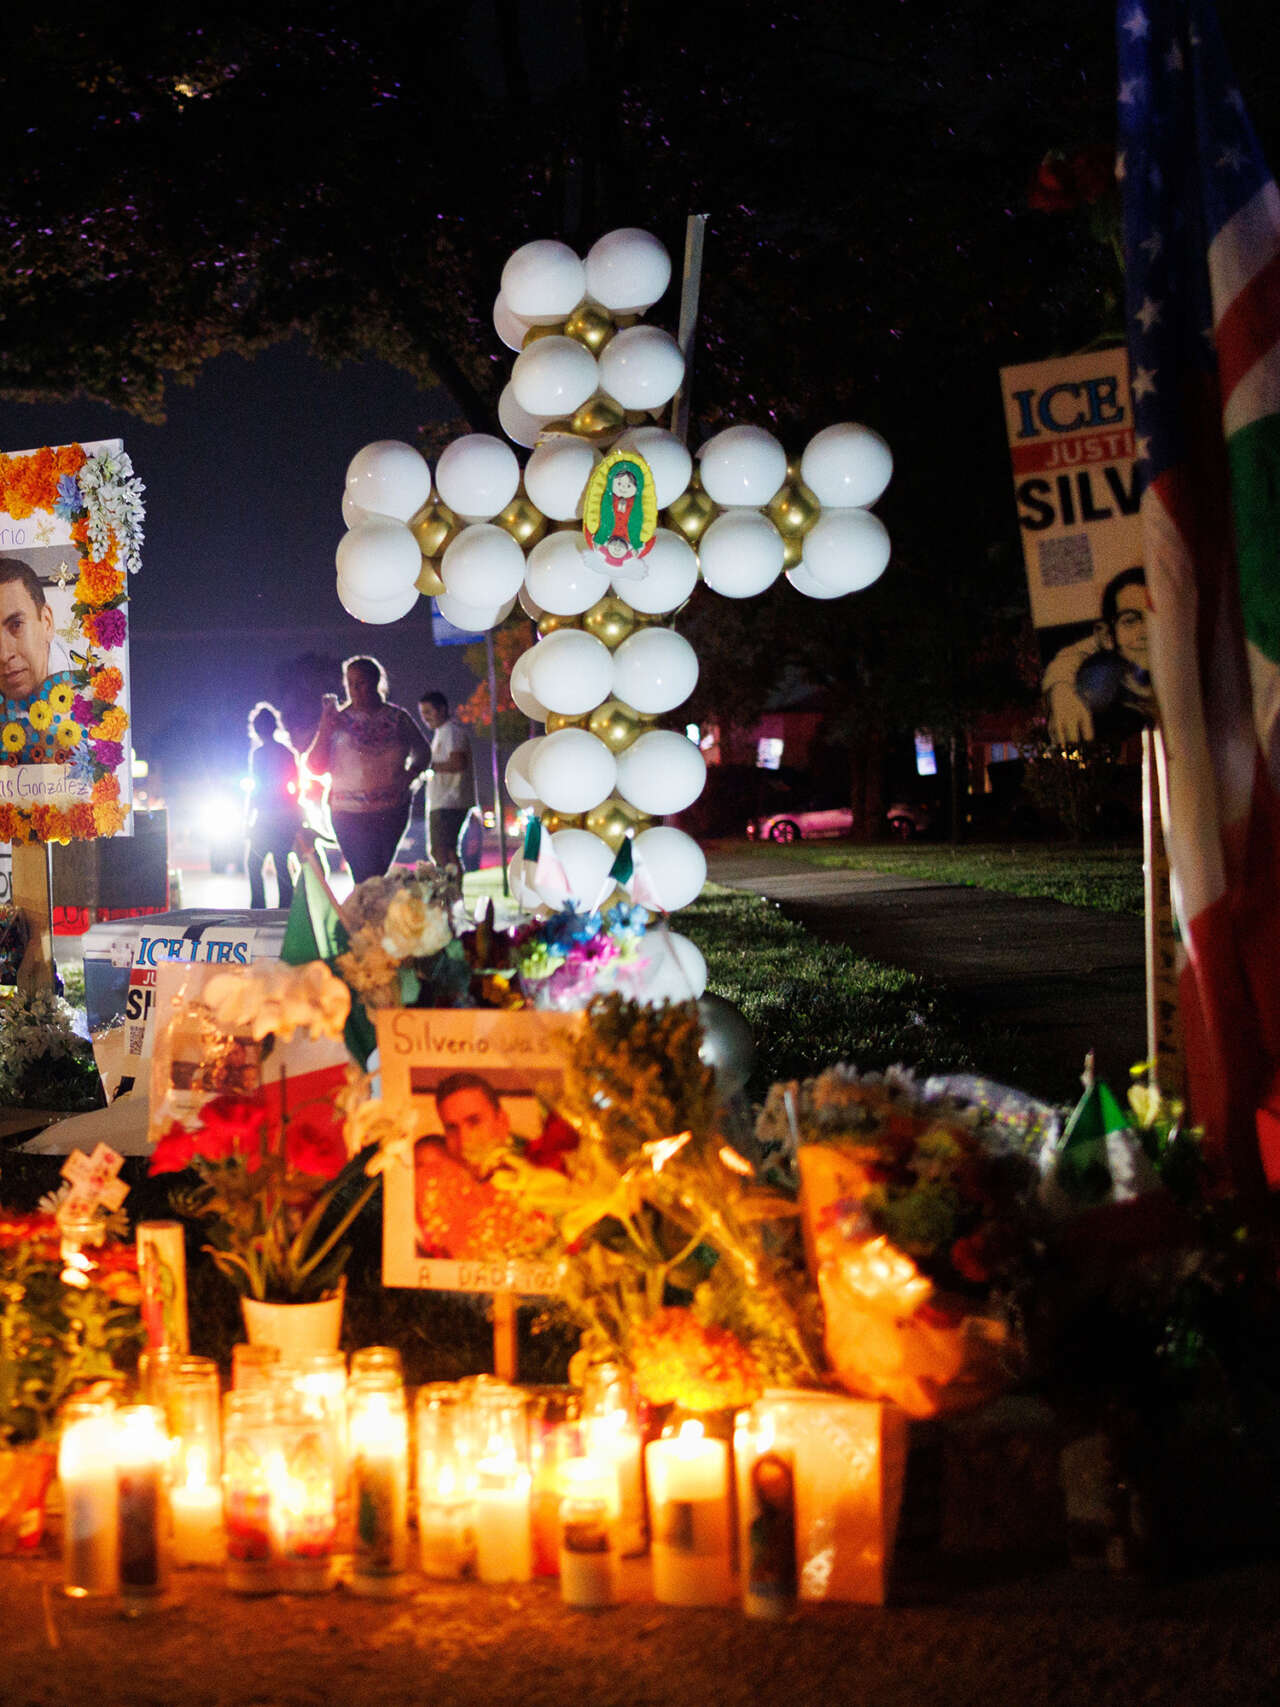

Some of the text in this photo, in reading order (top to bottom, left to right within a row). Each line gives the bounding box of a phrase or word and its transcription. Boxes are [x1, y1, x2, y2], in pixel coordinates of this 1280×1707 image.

[1012, 376, 1124, 438] ICE
[136, 937, 248, 966] ICE LIES
